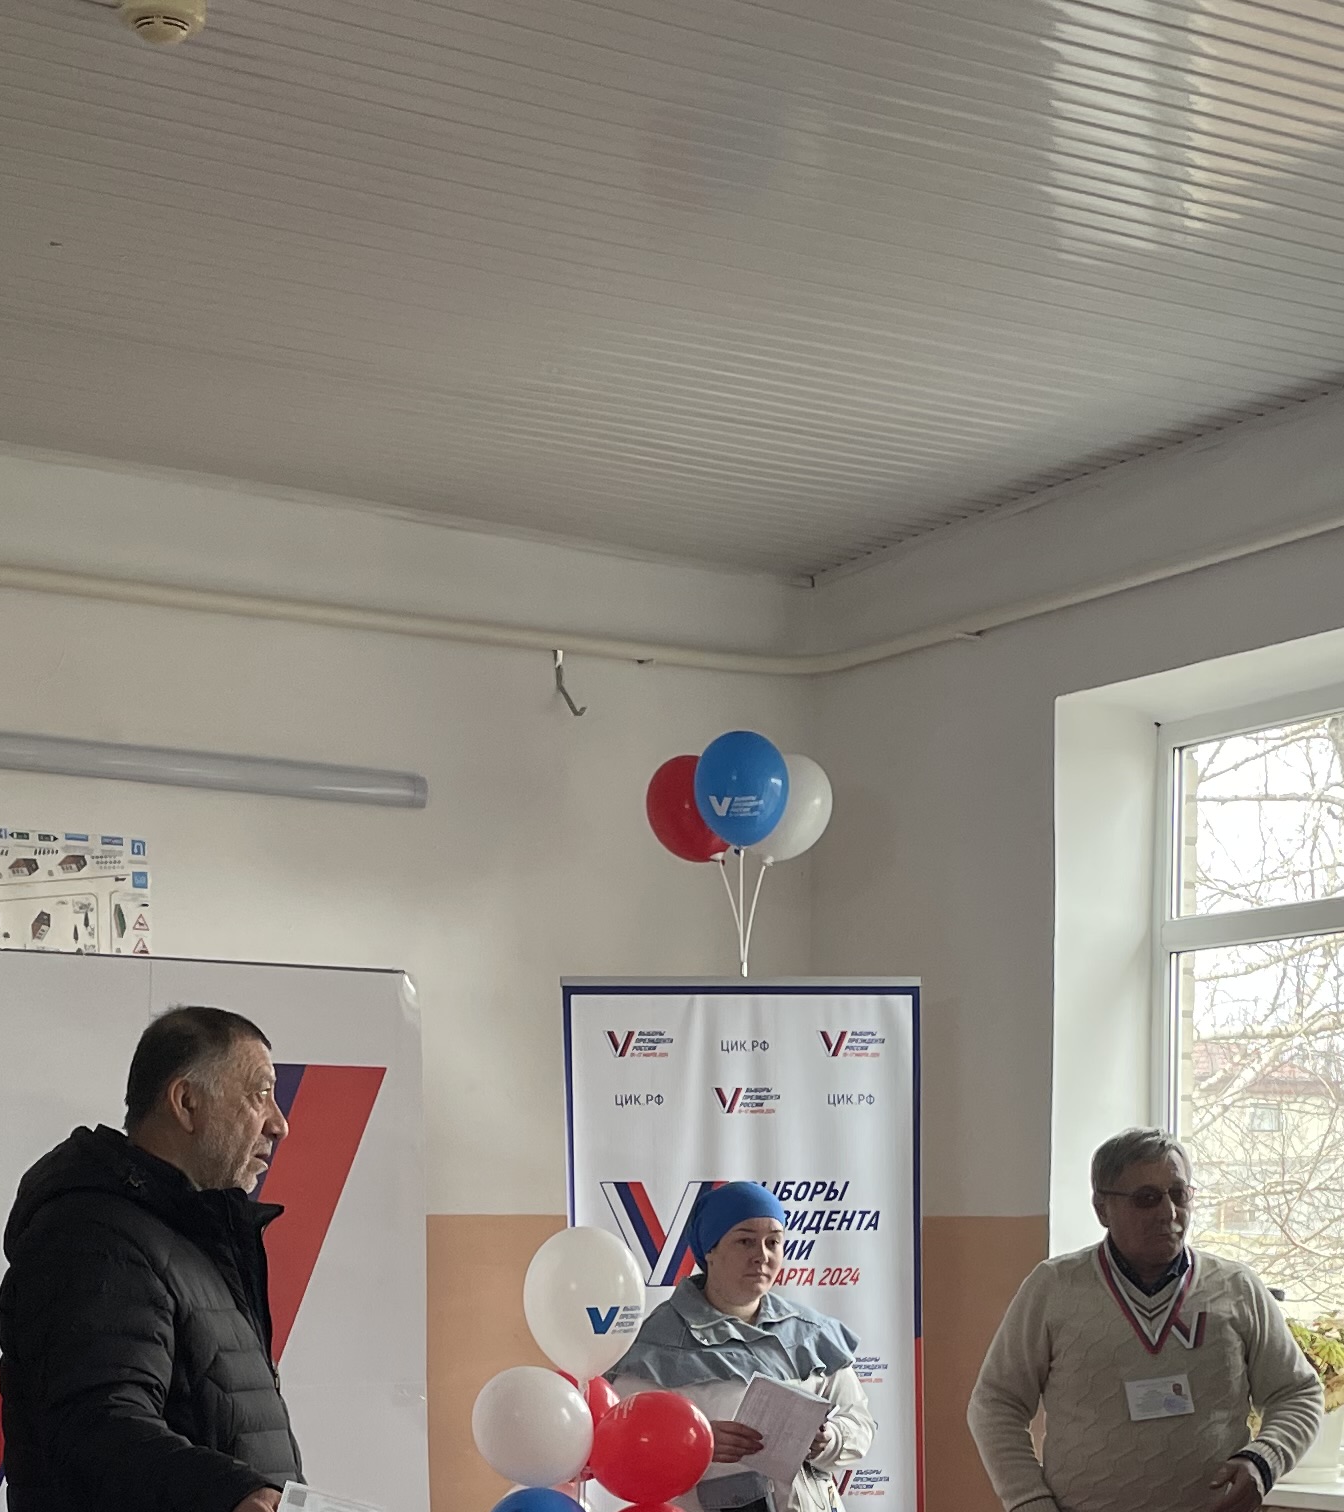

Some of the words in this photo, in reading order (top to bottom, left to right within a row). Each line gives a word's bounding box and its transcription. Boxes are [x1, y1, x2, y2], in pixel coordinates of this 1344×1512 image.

[720, 1039, 770, 1053] ЦИК.РФ
[614, 1094, 664, 1108] ЦИК.РФ
[827, 1094, 875, 1107] ЦИК.РФ
[761, 1181, 850, 1201] БОРЫ
[783, 1210, 880, 1234] ЗИДЕНТА
[772, 1268, 815, 1286] АРТА
[817, 1267, 861, 1286] 2024
